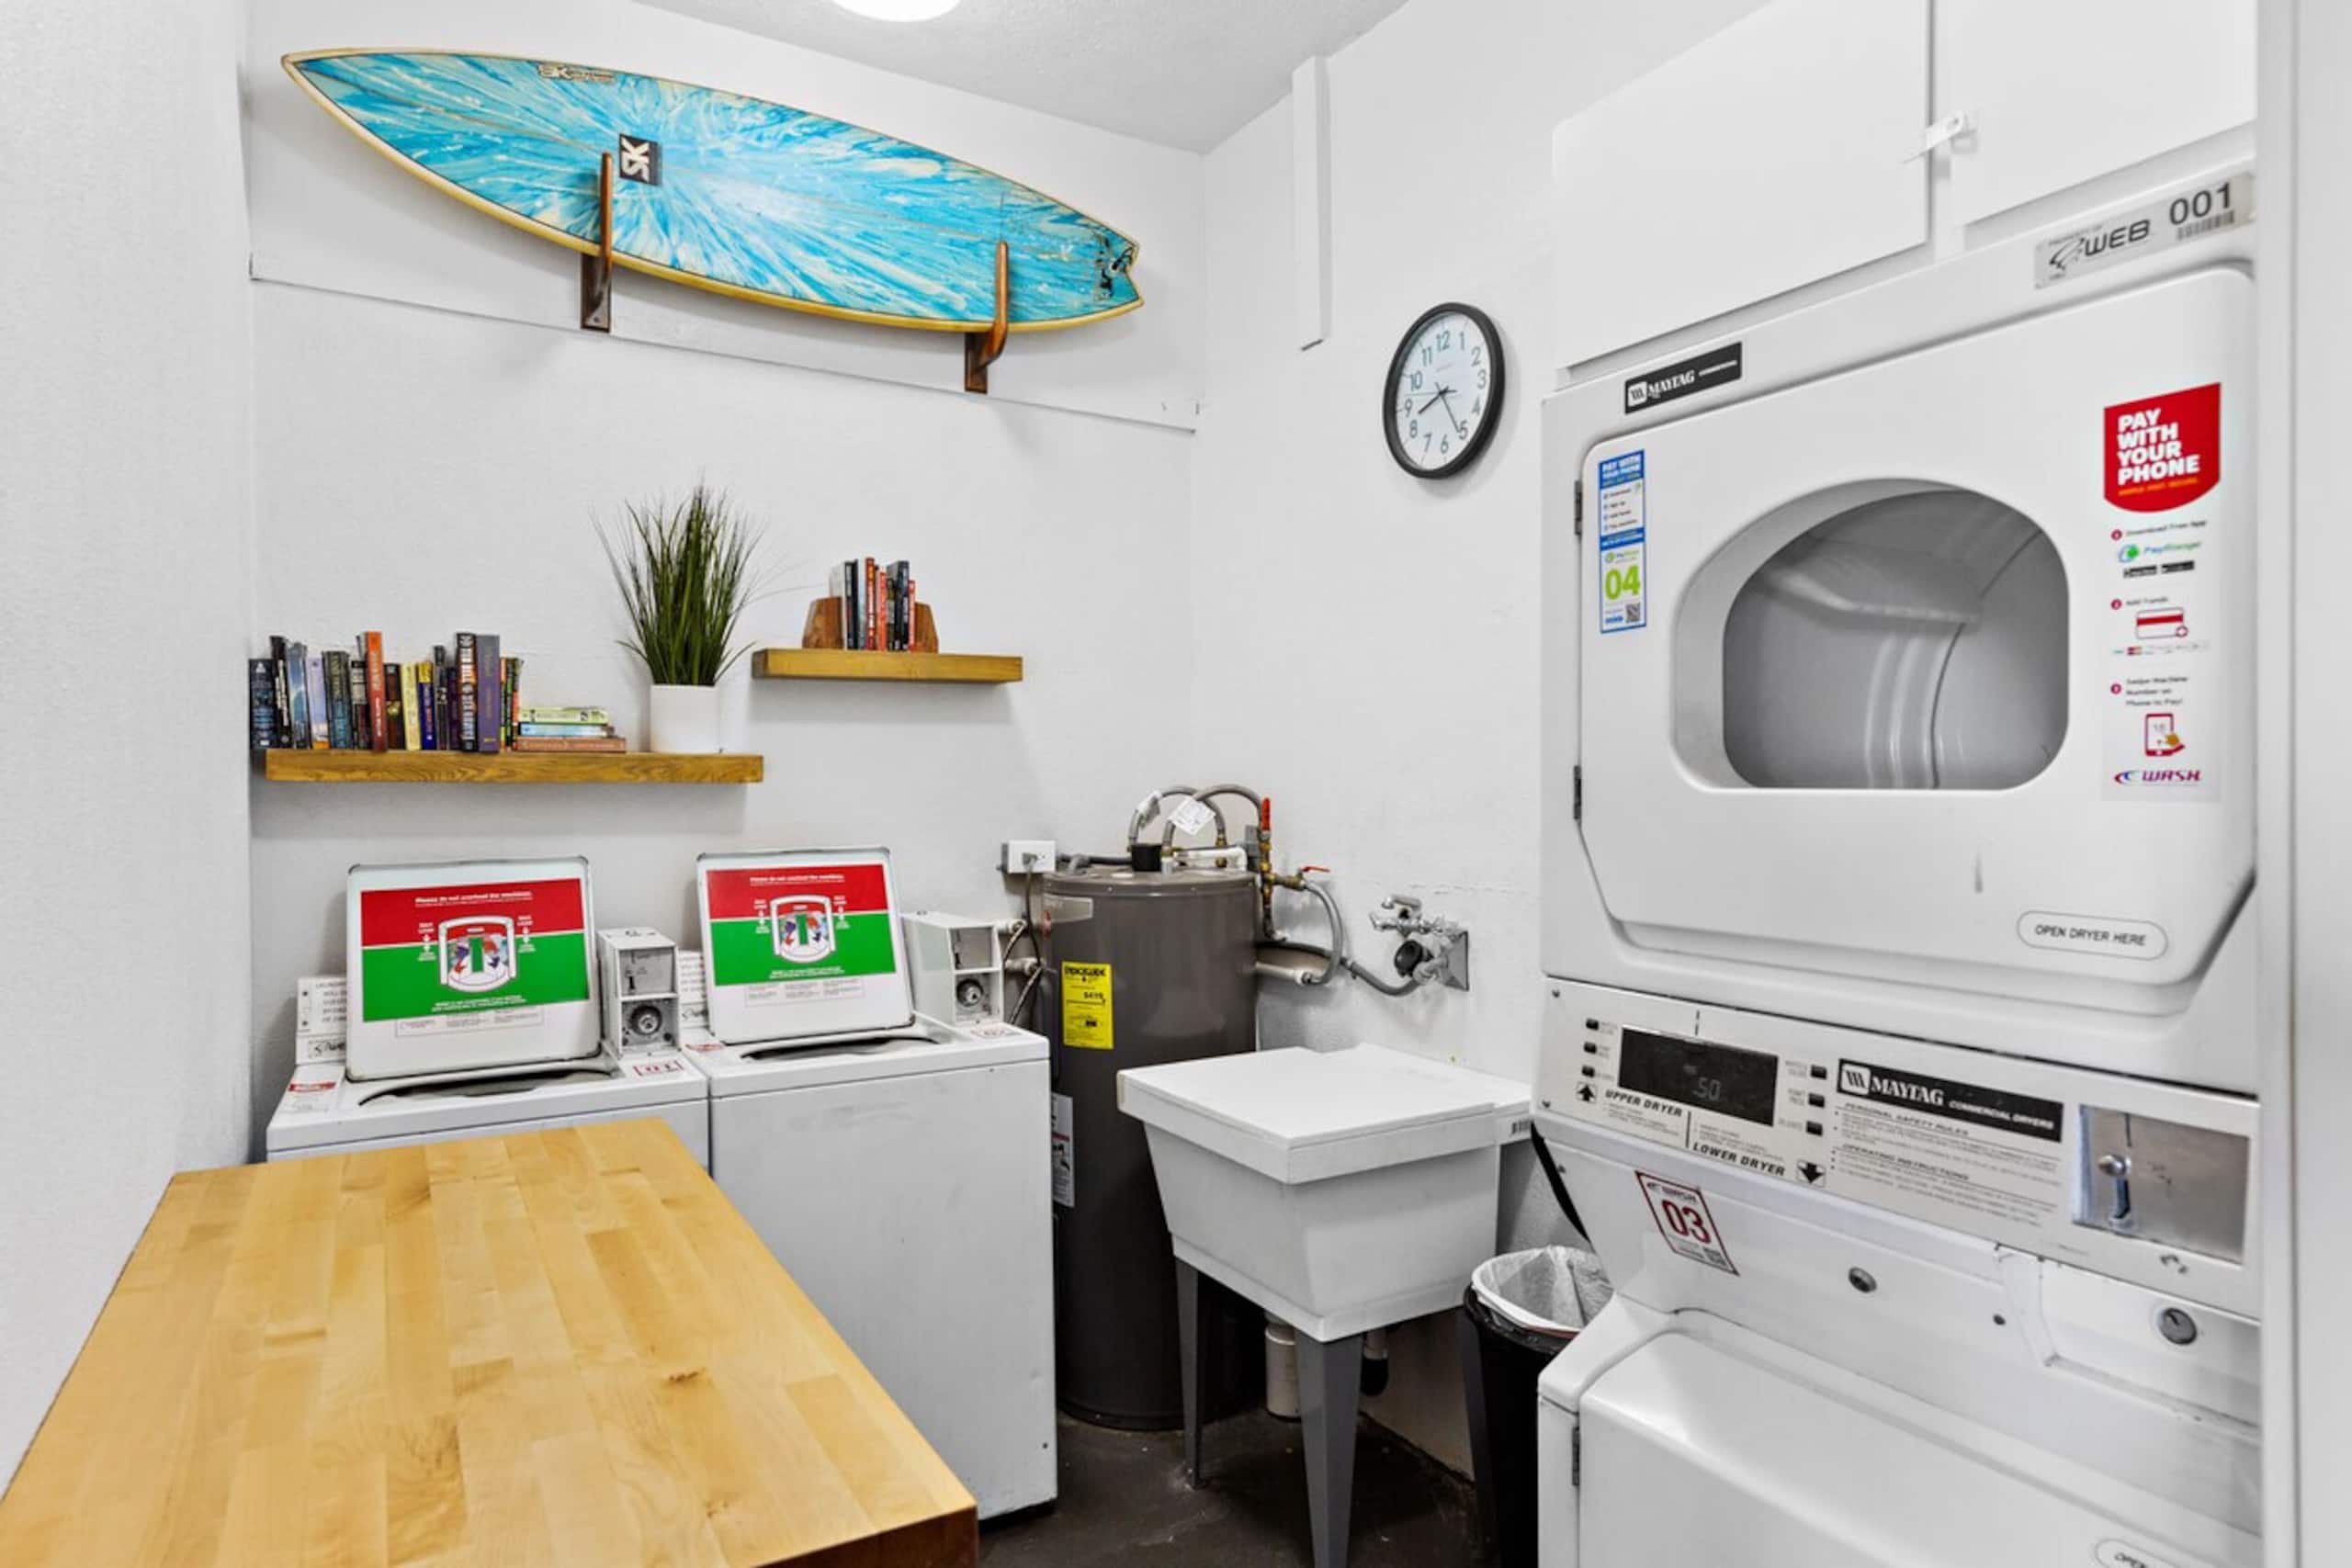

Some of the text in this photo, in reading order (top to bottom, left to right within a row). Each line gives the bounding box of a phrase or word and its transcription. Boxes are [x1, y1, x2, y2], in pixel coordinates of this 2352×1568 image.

[2085, 219, 2151, 256] WEB
[2169, 182, 2231, 226] 001
[1436, 330, 1451, 353] 12
[1459, 332, 1464, 351] 1
[1422, 346, 1432, 367] 11
[1471, 346, 1481, 367] 2
[1410, 370, 1423, 391] 10
[1477, 369, 1487, 389] 3
[1648, 368, 1696, 394] MAYTAG
[1405, 398, 1413, 418] 9
[1471, 396, 1481, 416] 4
[1409, 420, 1418, 439] 8
[1459, 420, 1469, 441] 5
[2117, 407, 2162, 434] PAY
[1423, 432, 1432, 453] 7
[1440, 434, 1449, 454] 6
[2117, 422, 2179, 450] WITH
[2117, 441, 2182, 467] YOUR
[2117, 454, 2201, 486] PHONE
[1604, 564, 1641, 601] 04
[2142, 768, 2202, 782] WASH
[2034, 924, 2147, 947] OPEN DRYER HERE
[1870, 1076, 1945, 1107] MAYTAG
[1605, 1089, 1683, 1118] UPPER DRYER
[1692, 1142, 1737, 1163] LOWER
[1740, 1156, 1786, 1177] DRYER
[1661, 1199, 1712, 1245] 03
